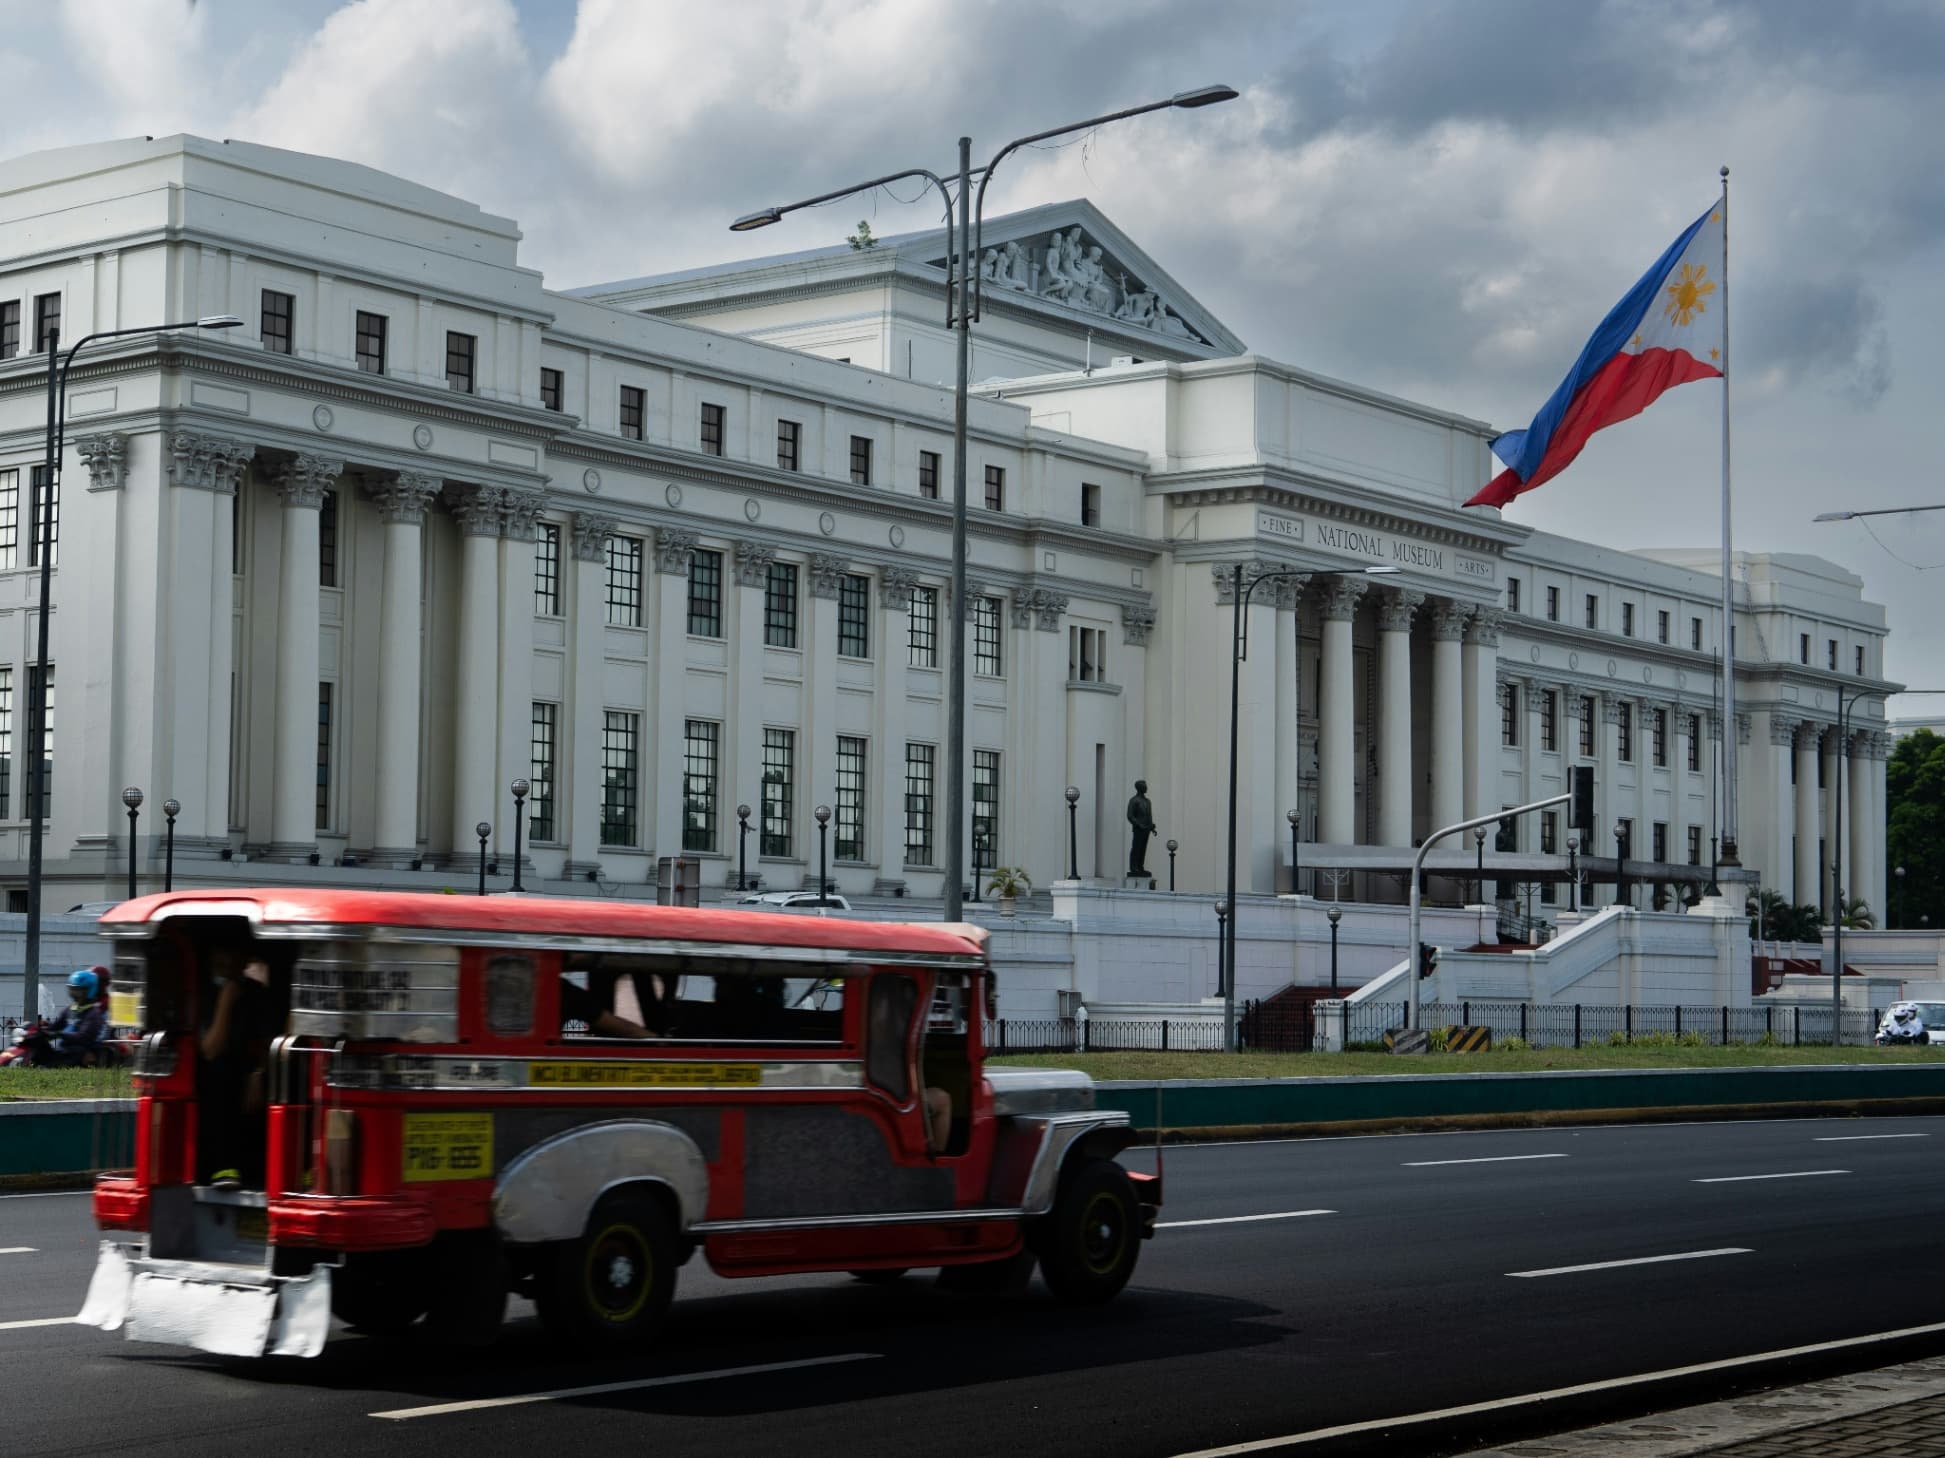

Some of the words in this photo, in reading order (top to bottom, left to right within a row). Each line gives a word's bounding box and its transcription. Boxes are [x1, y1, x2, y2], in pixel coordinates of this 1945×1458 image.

[1270, 518, 1292, 534] FINE
[1317, 524, 1384, 557] NATIONAL
[1392, 541, 1443, 570] MUSEUM
[1465, 561, 1486, 576] ARTS
